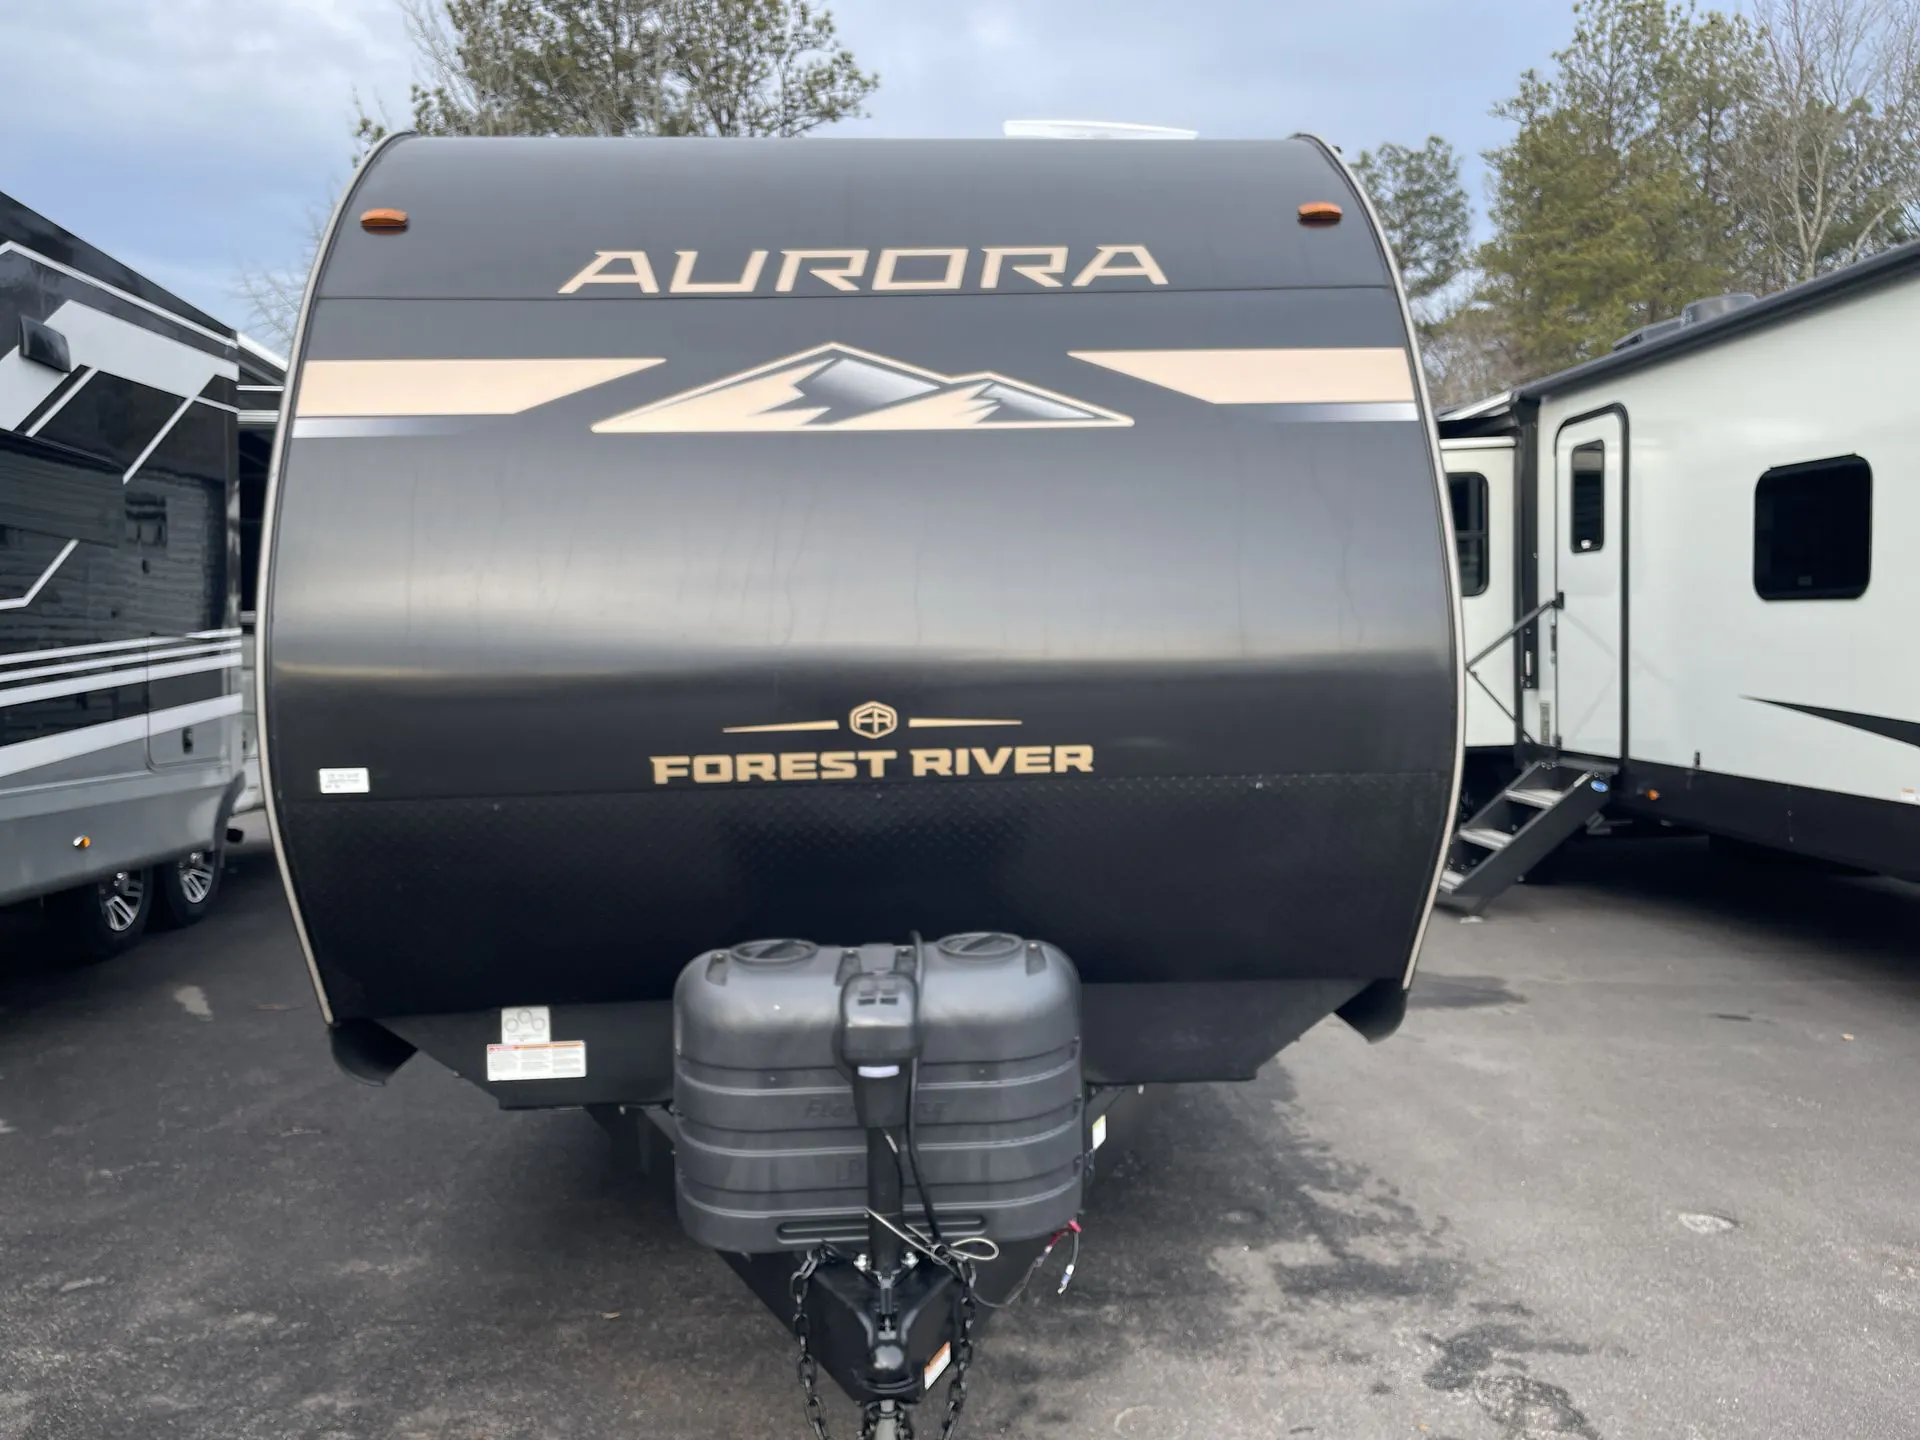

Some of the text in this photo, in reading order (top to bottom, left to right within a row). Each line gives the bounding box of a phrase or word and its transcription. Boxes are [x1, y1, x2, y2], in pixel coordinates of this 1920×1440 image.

[558, 245, 1169, 294] AURORA
[649, 744, 1094, 784] FOREST RIVER
